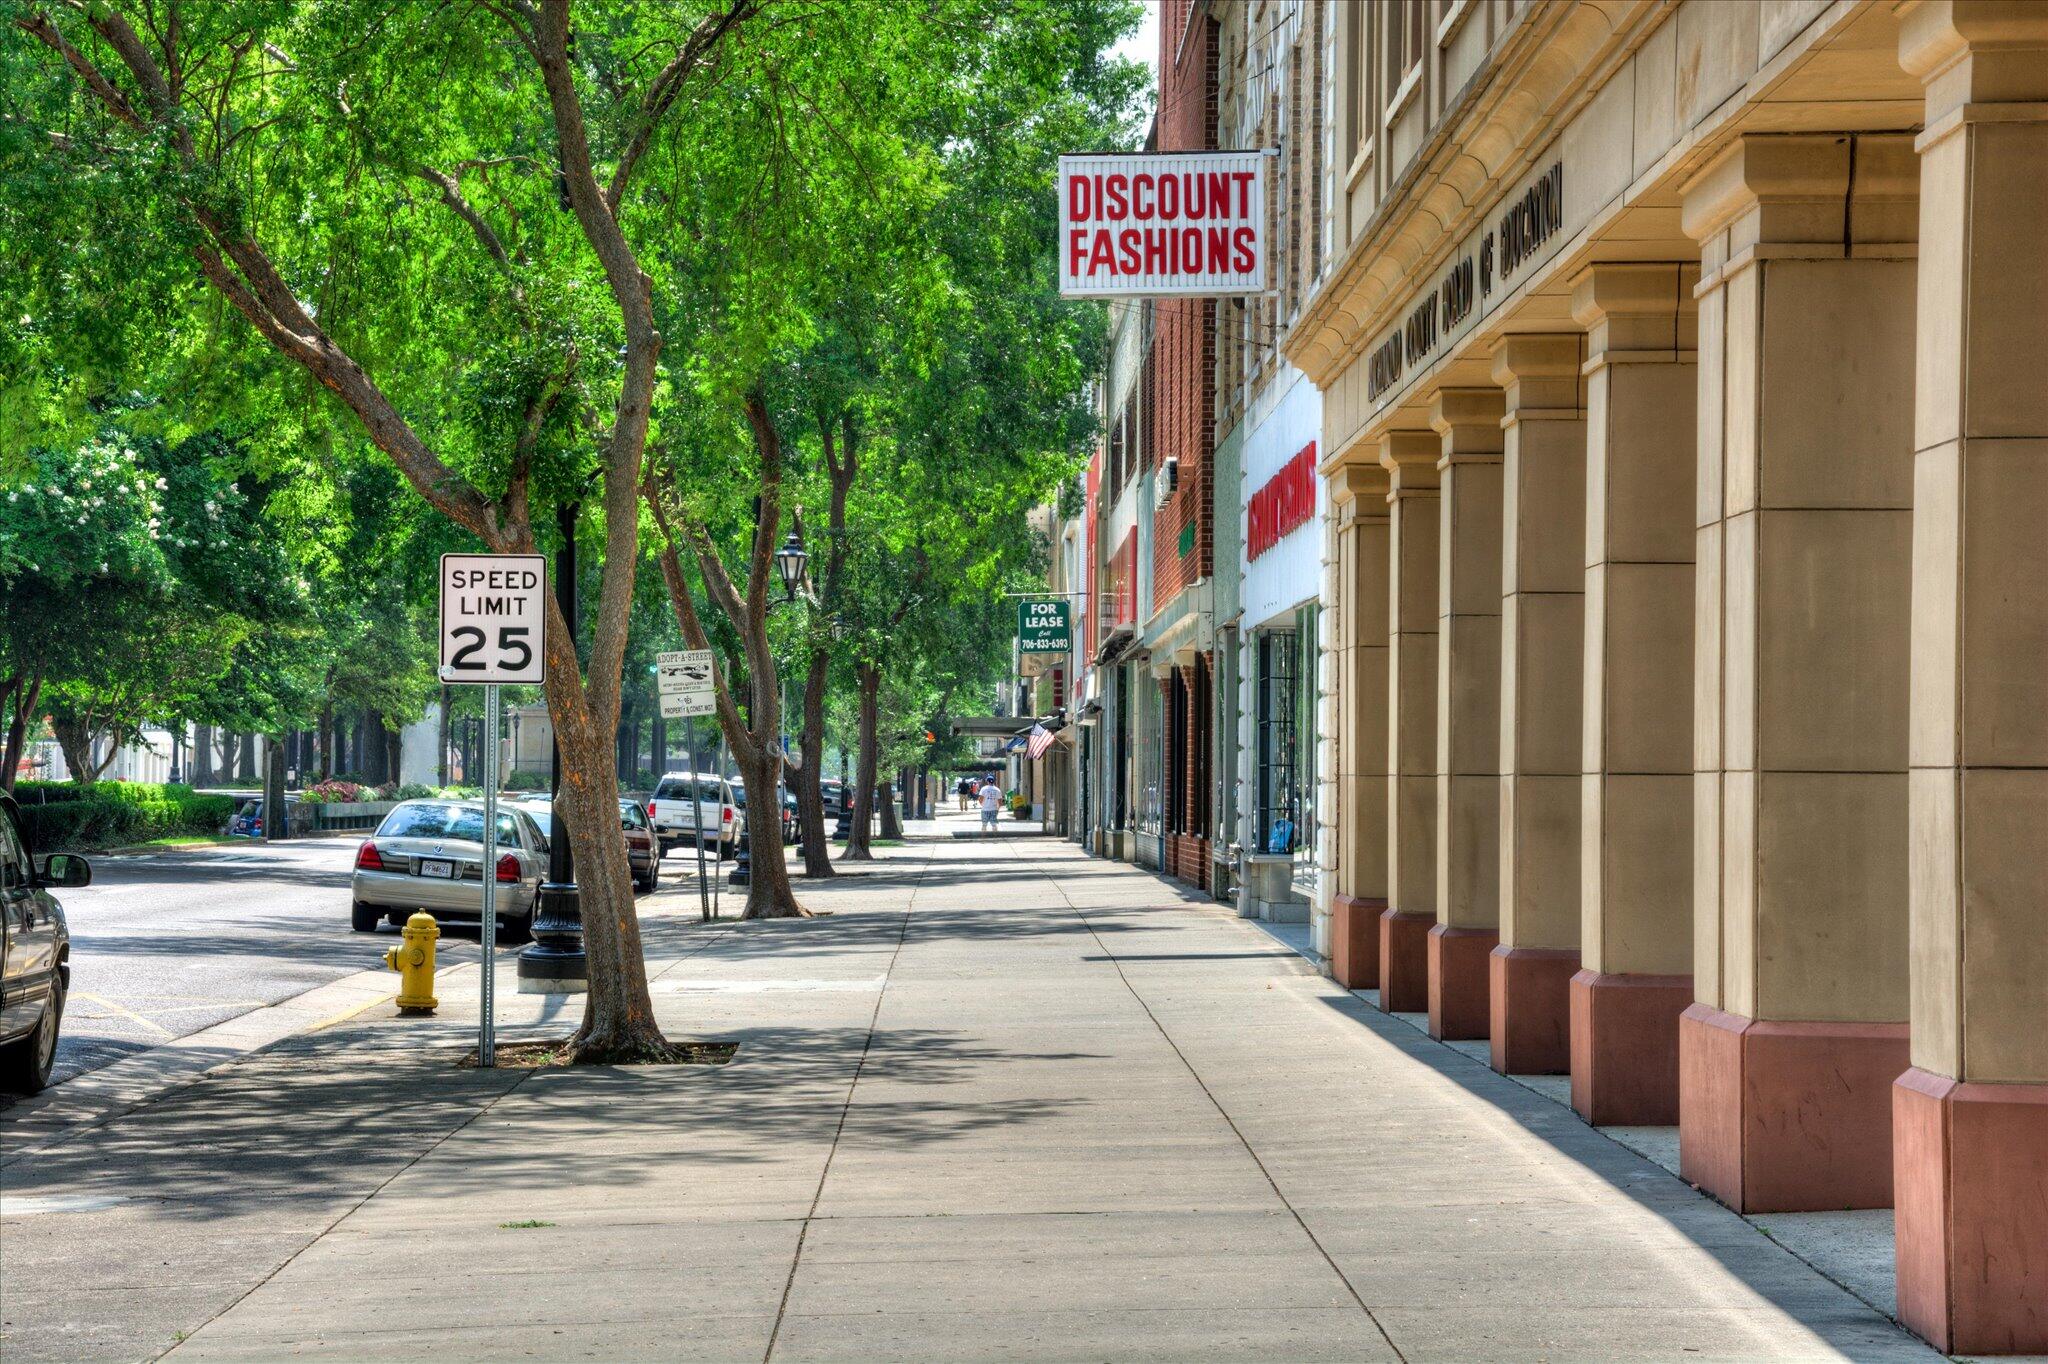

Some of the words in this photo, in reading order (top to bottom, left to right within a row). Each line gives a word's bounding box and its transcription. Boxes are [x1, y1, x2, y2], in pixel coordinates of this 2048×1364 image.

[1069, 172, 1255, 222] DISCOUNT
[1070, 227, 1255, 276] FASHIONS
[1480, 232, 1493, 299] OF
[452, 570, 537, 589] SPEED
[461, 597, 527, 615] LIMIT
[1031, 604, 1057, 615] FOR
[1025, 616, 1064, 628] LEASE
[450, 626, 532, 671] 25
[1022, 638, 1068, 649] 706-833-6393
[657, 652, 712, 664] ADOPT-A-STREET
